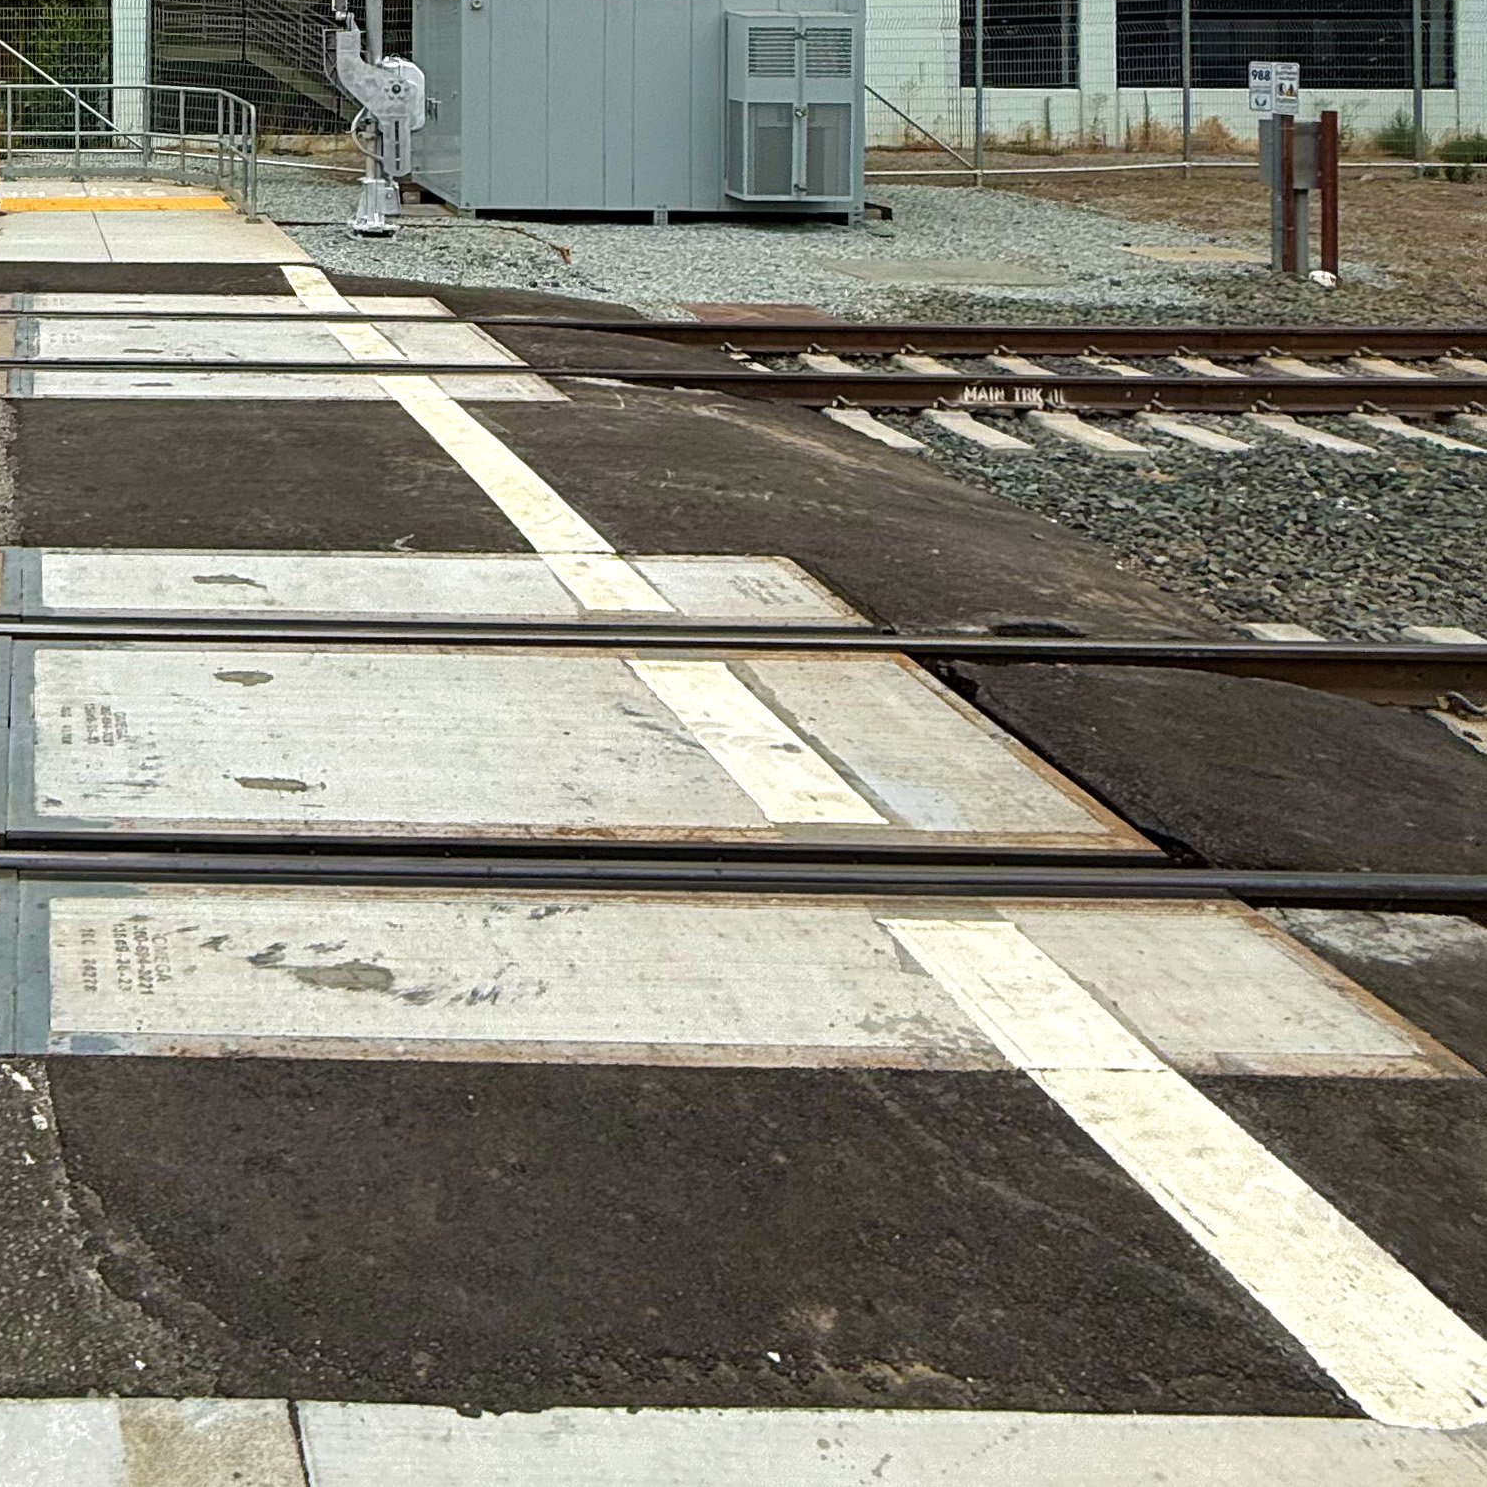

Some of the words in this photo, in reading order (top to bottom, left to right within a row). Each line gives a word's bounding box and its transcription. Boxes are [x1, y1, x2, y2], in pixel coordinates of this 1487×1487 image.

[1252, 69, 1271, 81] 988
[963, 385, 1006, 402] MAIN
[1013, 387, 1044, 404] TRK
[152, 935, 173, 982] OMEGA
